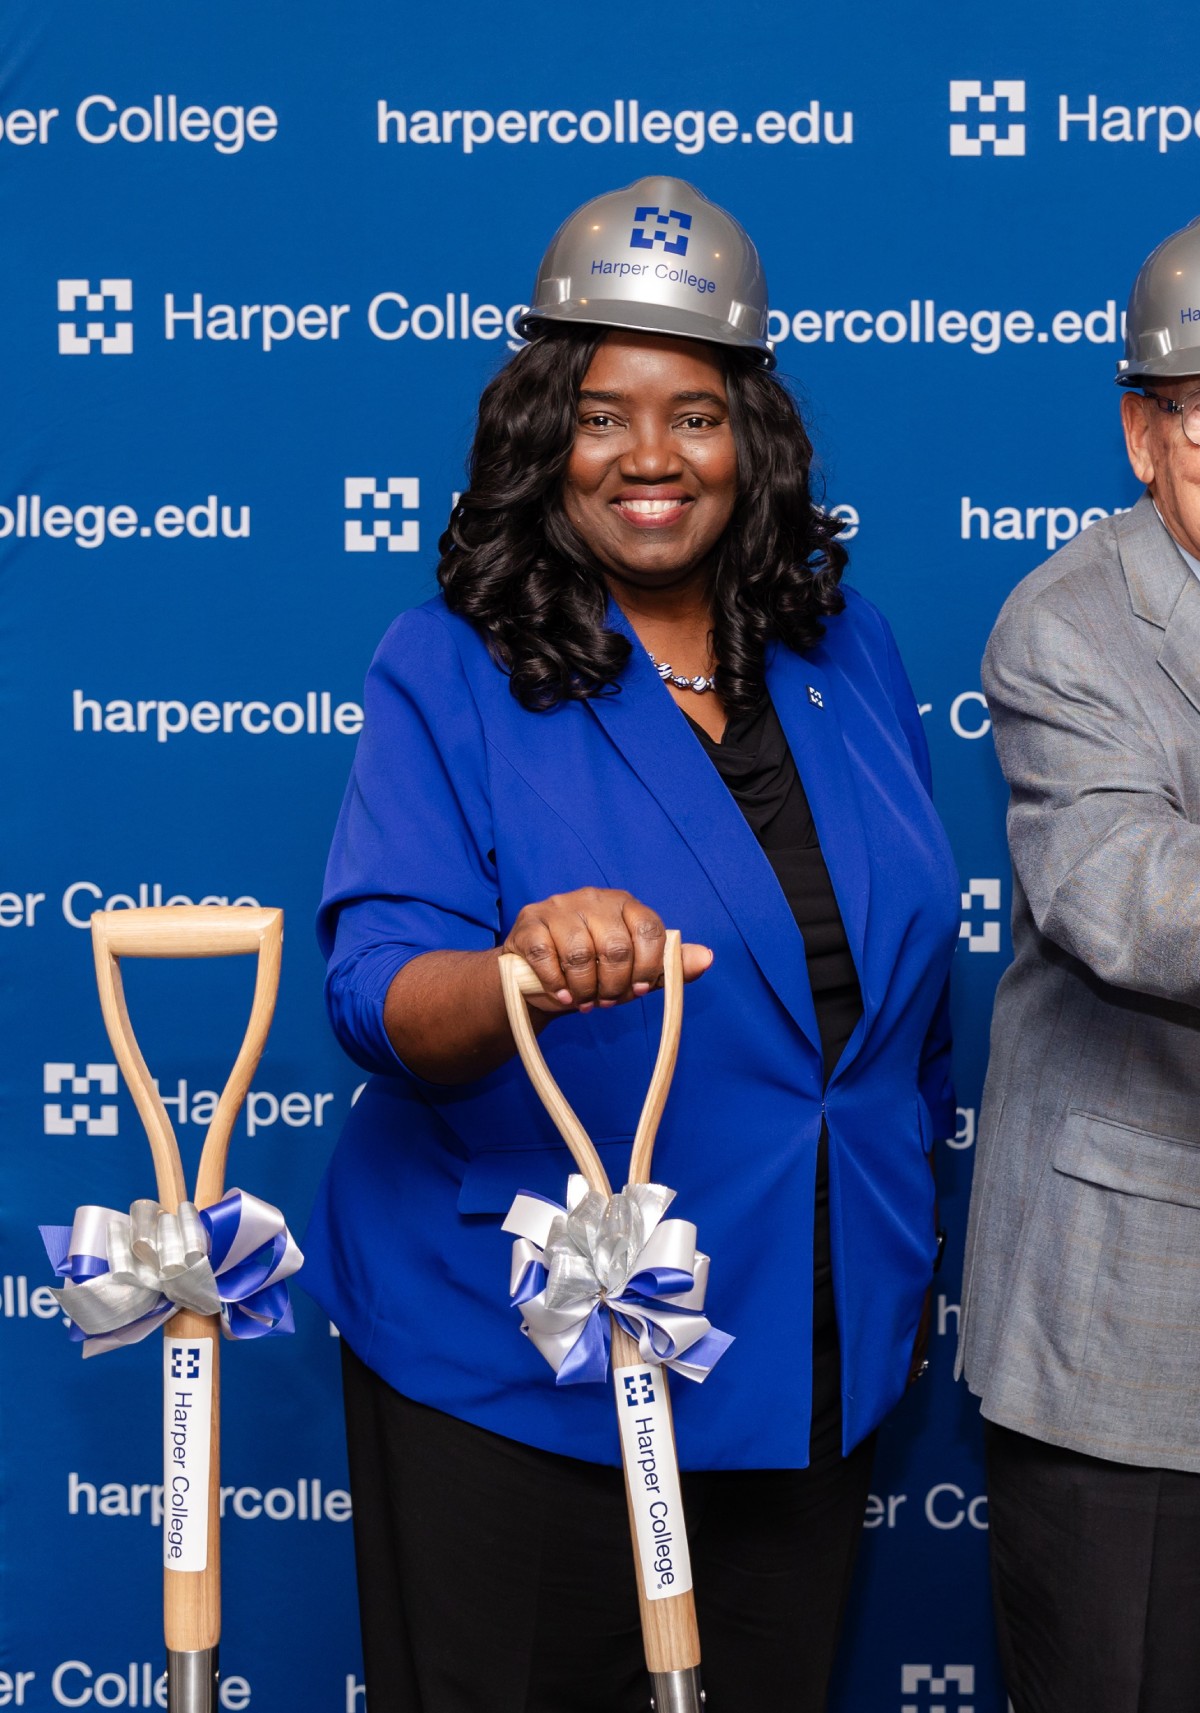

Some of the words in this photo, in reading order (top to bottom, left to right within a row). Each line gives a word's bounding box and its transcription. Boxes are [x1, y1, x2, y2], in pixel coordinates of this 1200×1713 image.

[76, 93, 279, 155] College
[377, 99, 853, 155] harpercollege.edu
[591, 260, 649, 278] Harper
[654, 263, 716, 293] College
[165, 292, 351, 352] Harper
[367, 291, 531, 352] Colleg
[768, 299, 1127, 356] percollege.ed
[73, 690, 364, 743] harpercolle
[153, 1078, 334, 1137] Haper
[170, 1391, 193, 1469] Harper
[635, 1416, 661, 1494] Harper
